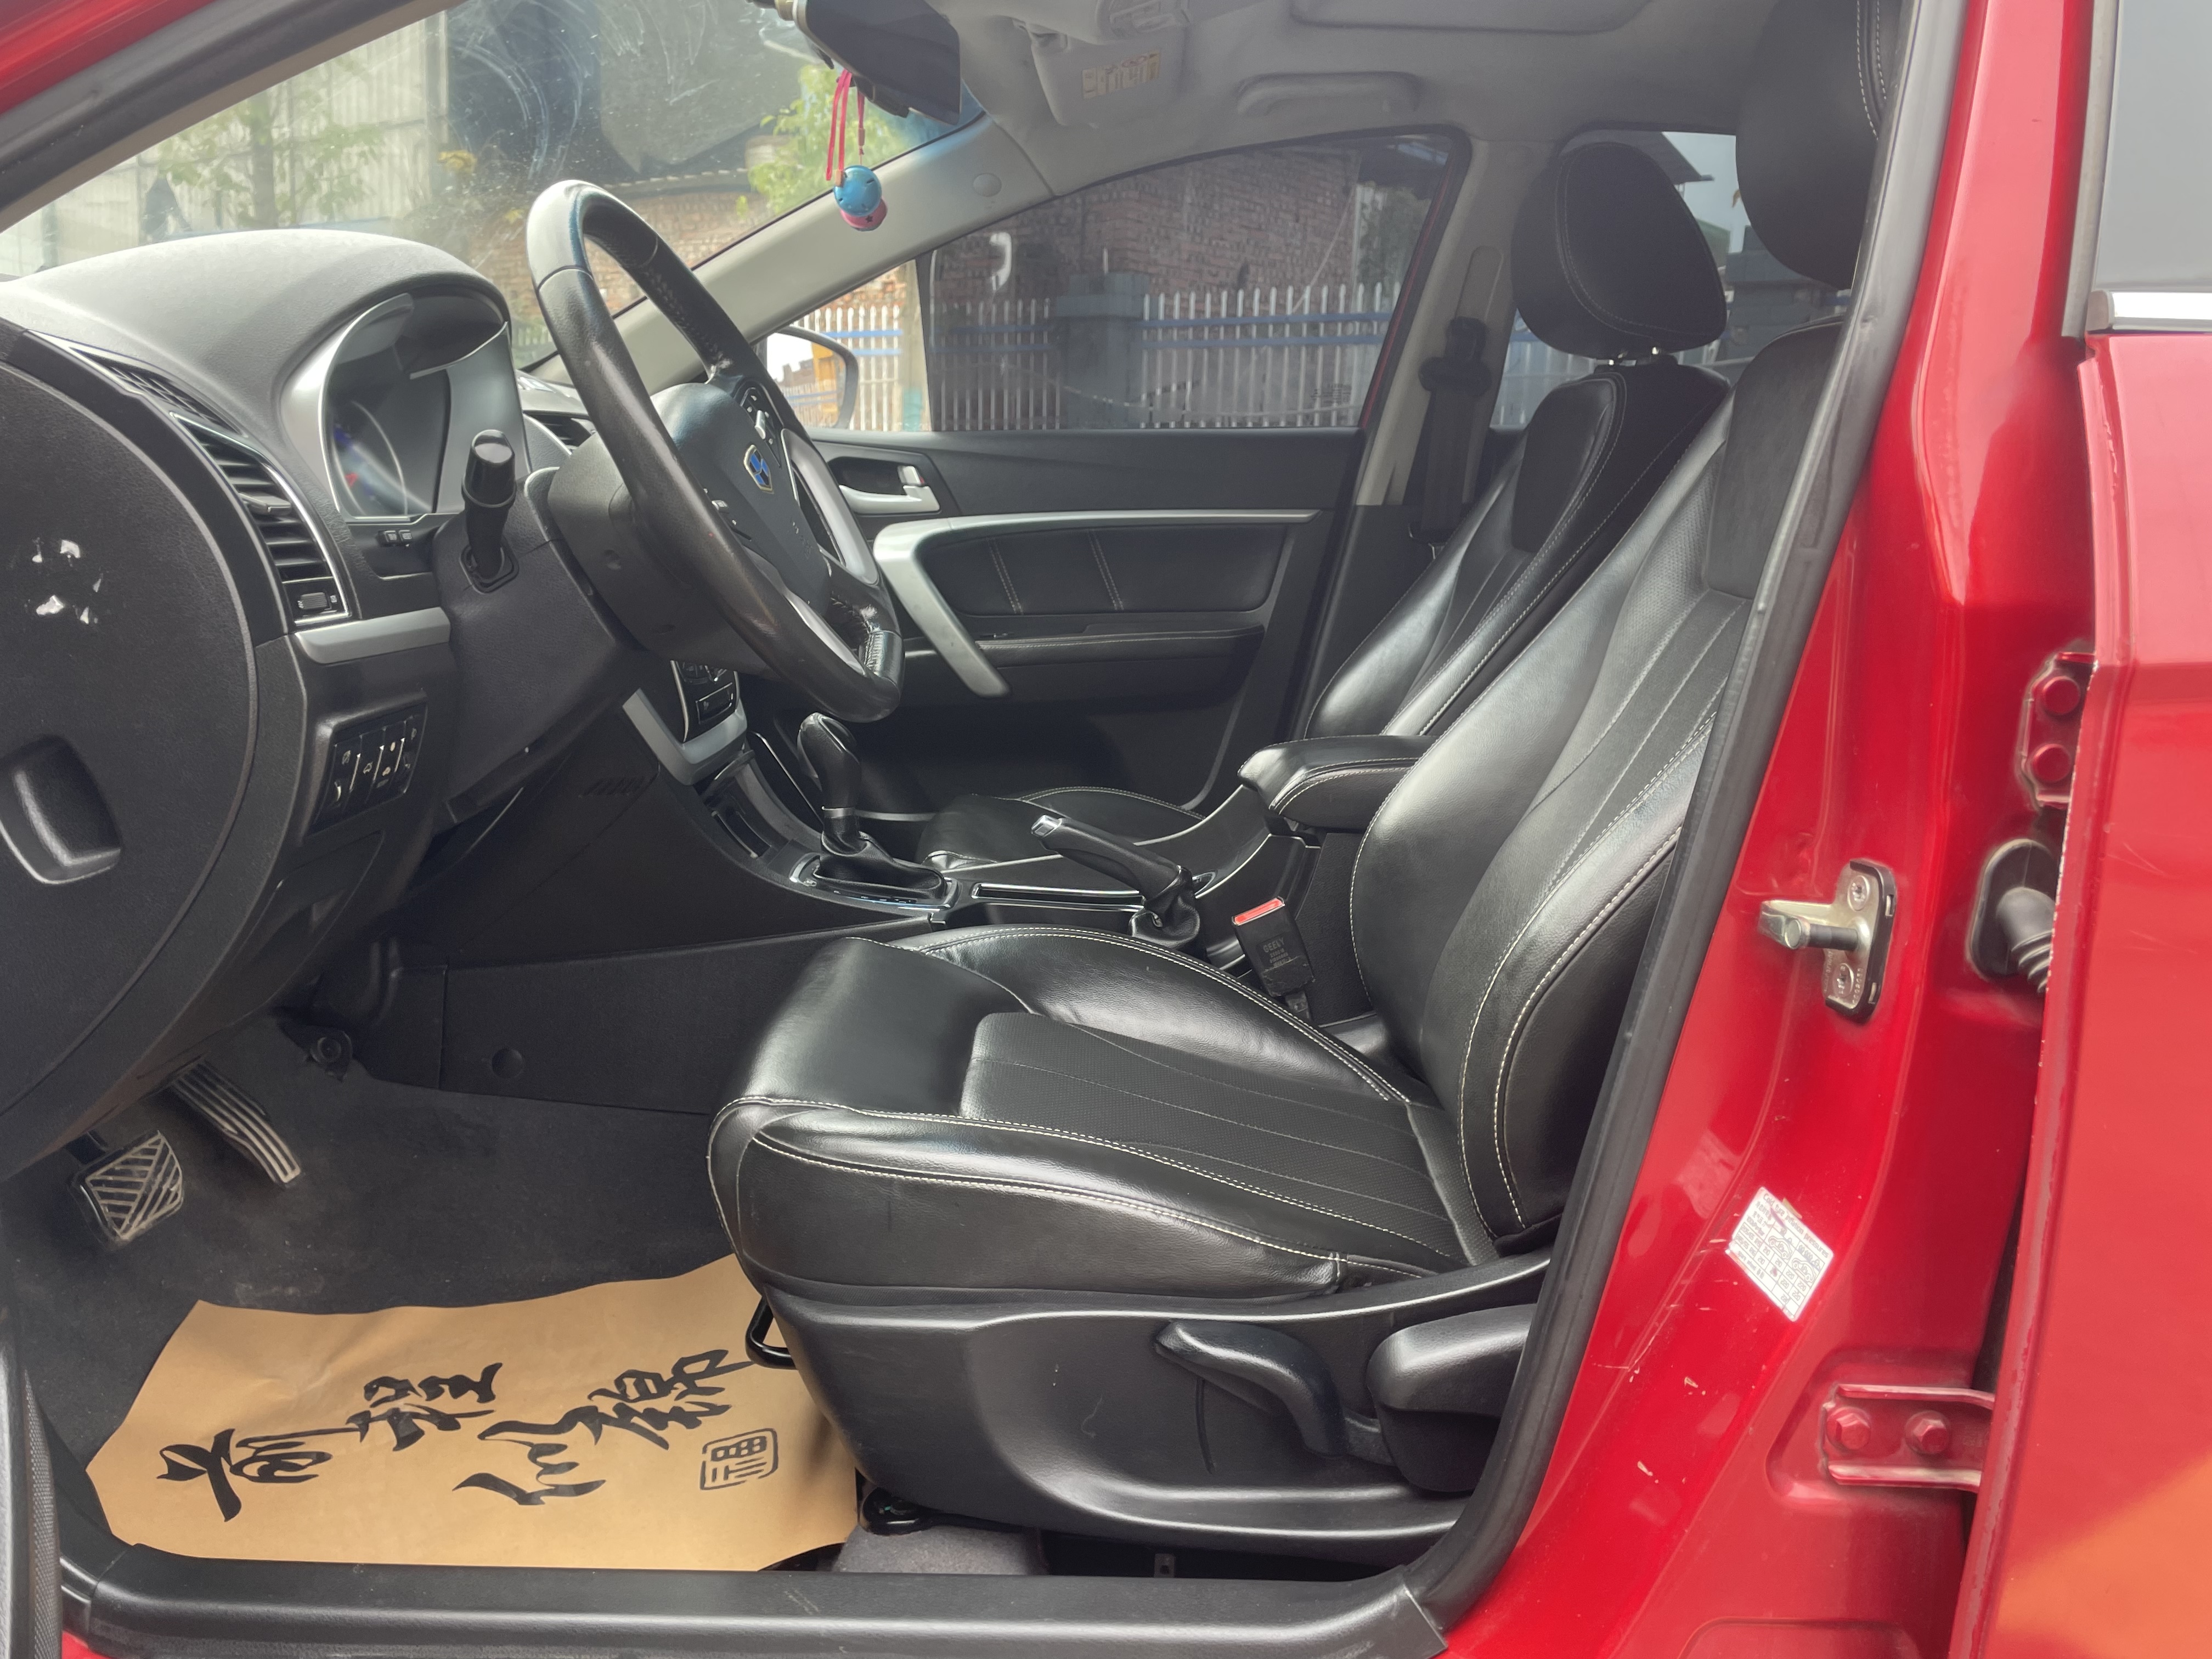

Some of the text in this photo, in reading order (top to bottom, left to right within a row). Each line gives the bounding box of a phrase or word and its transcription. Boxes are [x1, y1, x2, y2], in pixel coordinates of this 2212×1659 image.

[1263, 937, 1285, 953] GEELY
[1762, 1192, 1775, 1206] Cold
[1803, 1232, 1829, 1260] pressures
